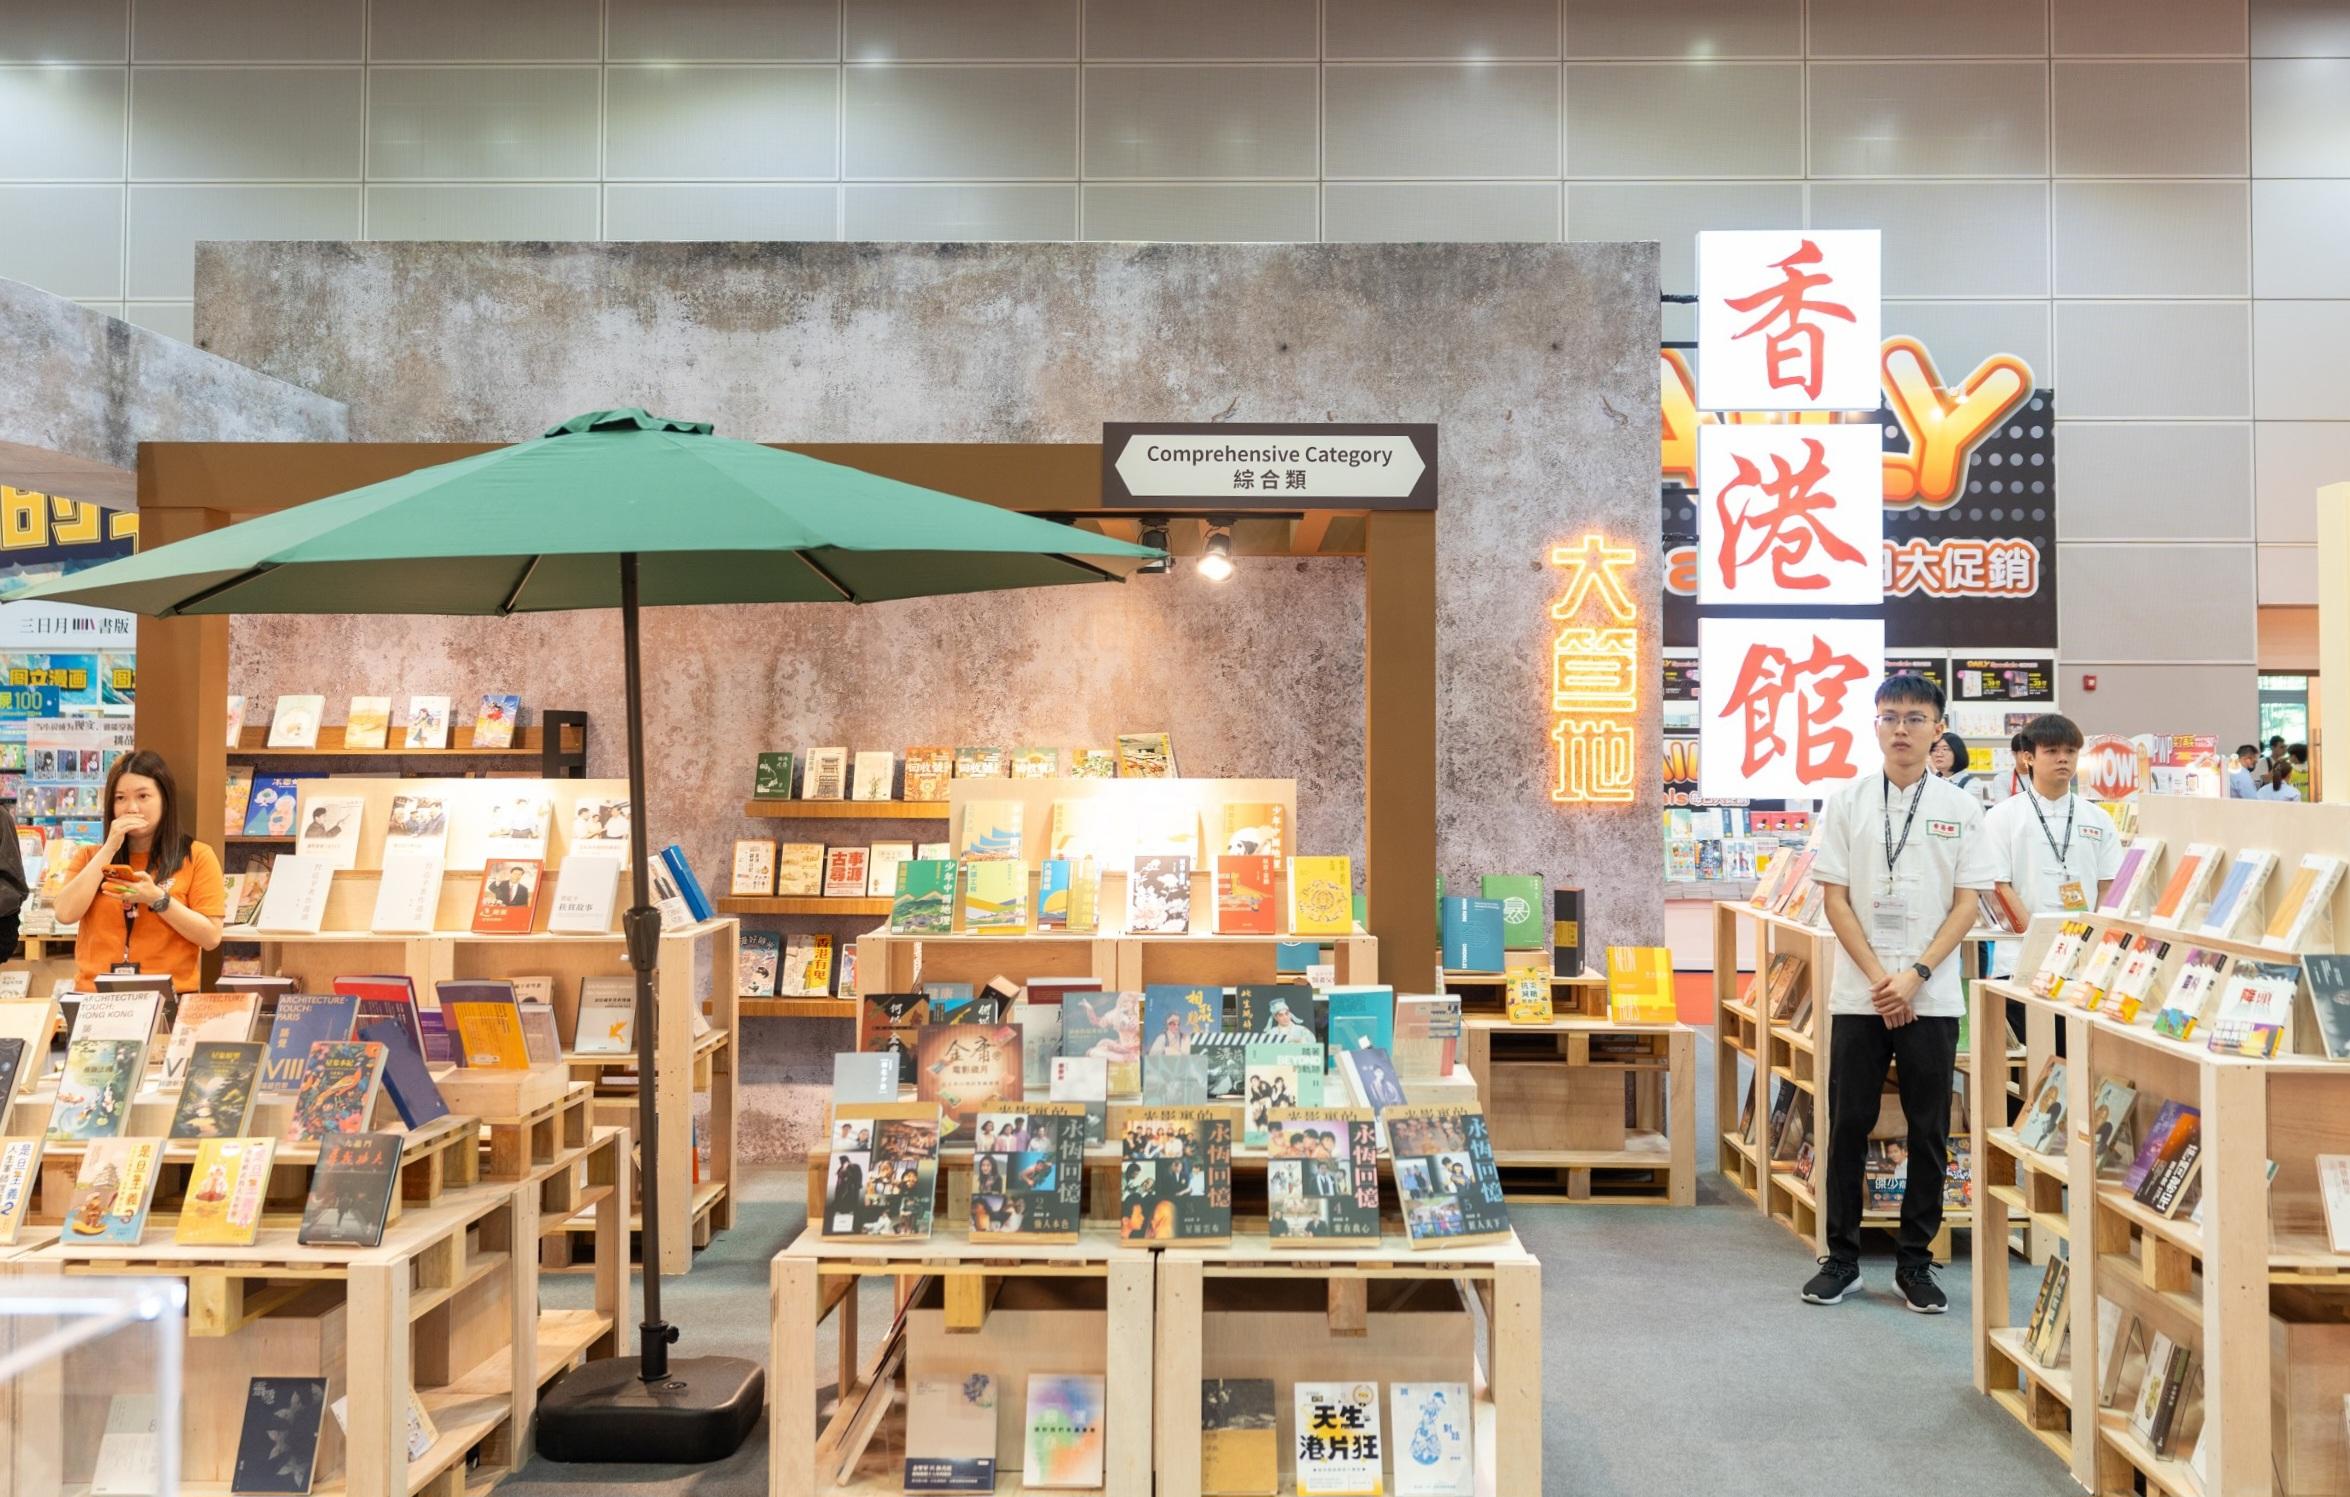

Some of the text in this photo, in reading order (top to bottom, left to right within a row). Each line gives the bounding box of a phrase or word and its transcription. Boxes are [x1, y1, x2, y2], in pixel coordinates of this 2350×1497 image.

[1147, 445, 1393, 467] Comprehensive Category
[1233, 469, 1307, 490] 綜合類
[1717, 239, 1869, 785] 香港館
[20, 616, 130, 634] 三日月 書版
[2089, 747, 2138, 788] WOW!
[79, 1010, 134, 1019] HONG KONG
[276, 1013, 301, 1021] PARIS
[945, 1035, 996, 1063] 金庸
[1278, 1056, 1321, 1065] BEYOND
[1313, 1405, 1364, 1429] 天生
[1300, 1435, 1379, 1461] 港片狂
